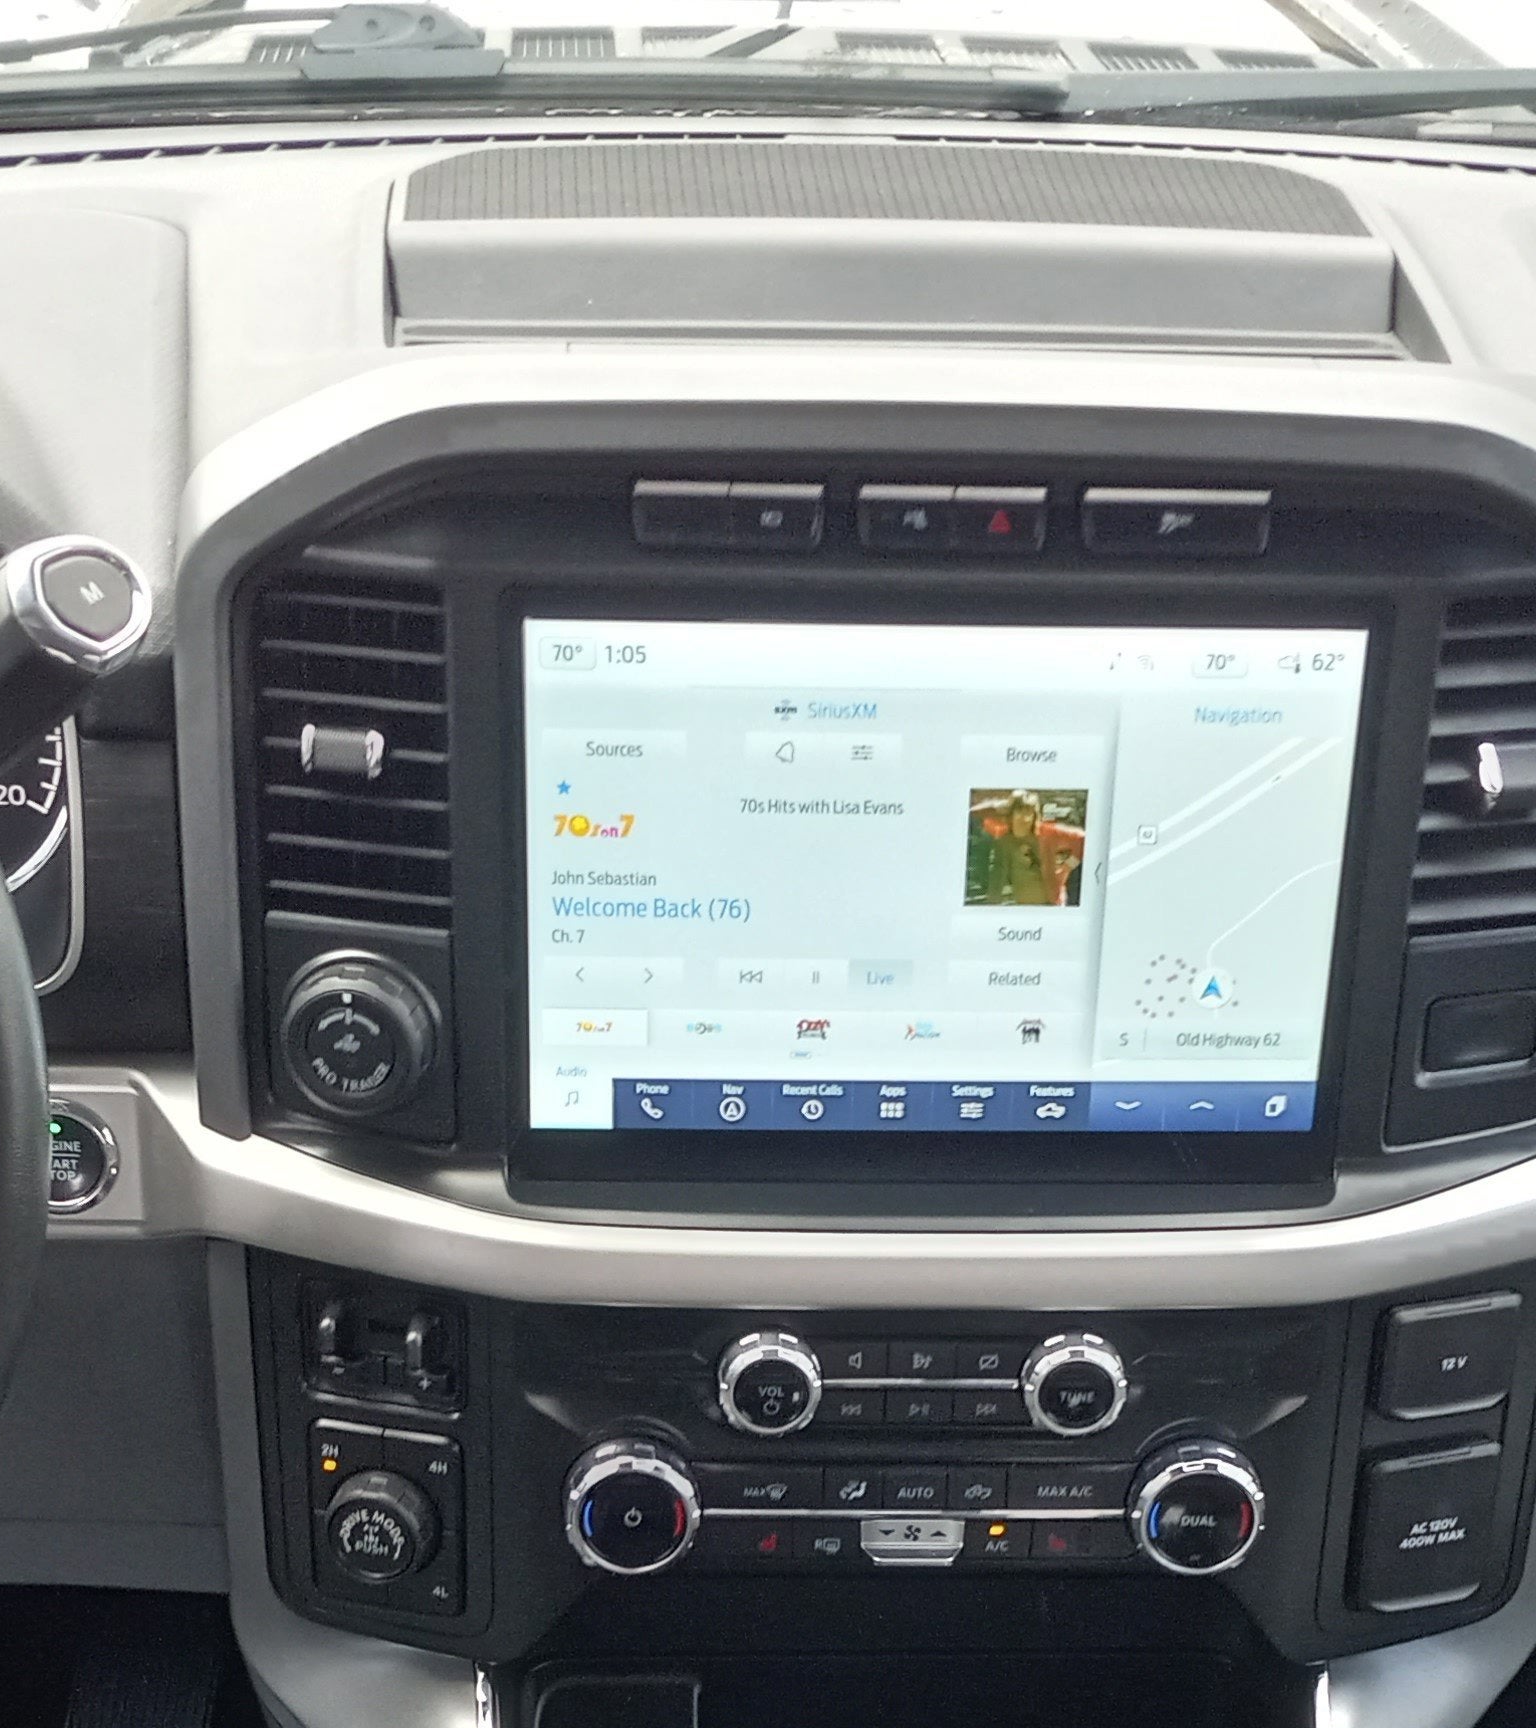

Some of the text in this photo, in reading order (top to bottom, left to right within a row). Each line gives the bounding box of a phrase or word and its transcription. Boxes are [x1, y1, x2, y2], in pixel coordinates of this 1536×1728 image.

[80, 581, 105, 605] M
[605, 645, 646, 664] 1:05
[808, 702, 878, 719] SiriusXM
[1195, 707, 1282, 725] Navigation
[585, 741, 643, 757] Sources
[1006, 747, 1057, 763] Browse
[741, 800, 904, 816] 70s Hits with Lisa Evans
[552, 870, 657, 887] John Sebastian
[553, 897, 750, 923] Welcome Back (76)
[551, 929, 585, 944] Ch. 7
[998, 927, 1042, 941] Sound
[866, 971, 894, 985] Live
[989, 971, 1041, 986] Related
[1176, 1032, 1280, 1051] Old Highway 62
[556, 1066, 587, 1078] Audio
[636, 1082, 669, 1095] Phone
[723, 1083, 743, 1095] Nav
[782, 1084, 843, 1096] Recent Calls
[880, 1084, 906, 1099] Apps
[951, 1084, 994, 1099] Settings
[1030, 1085, 1075, 1097] Features
[51, 1141, 82, 1153] GINE
[52, 1160, 79, 1170] ART
[51, 1171, 77, 1181] TOP
[758, 1387, 784, 1397] VOL
[1060, 1391, 1095, 1403] TUNE
[321, 1444, 339, 1457] 2H
[429, 1461, 447, 1475] 4H
[897, 1486, 934, 1499] AUTO
[1037, 1486, 1093, 1498] MAX A/C
[1181, 1516, 1215, 1527] DUAL
[1410, 1523, 1428, 1535] AC
[1438, 1528, 1466, 1543] MAX
[985, 1540, 1009, 1552] A/C
[433, 1586, 449, 1598] 4L
